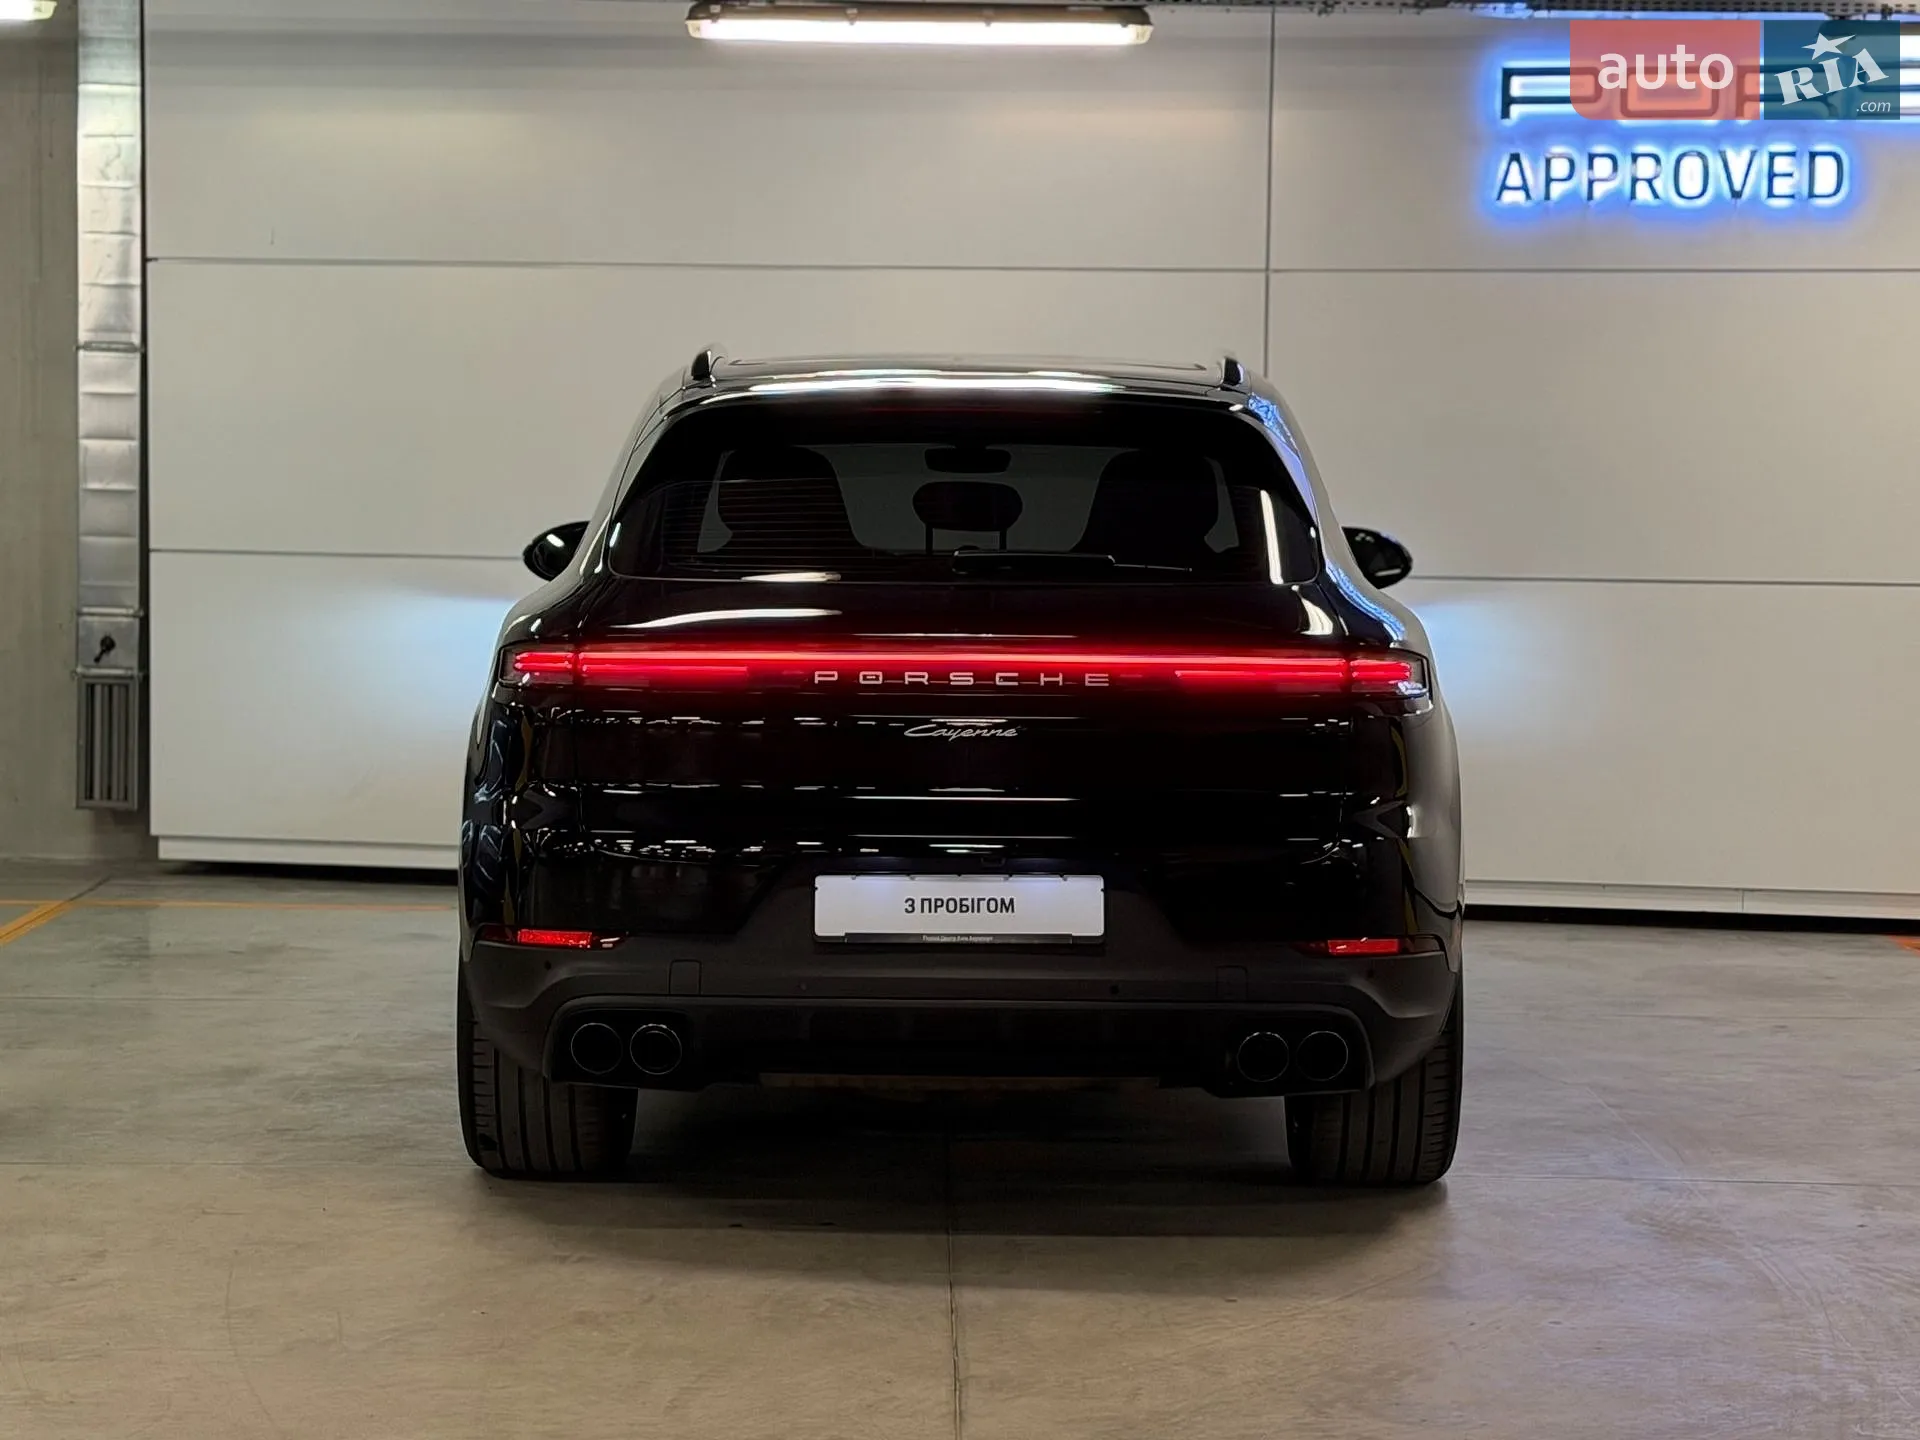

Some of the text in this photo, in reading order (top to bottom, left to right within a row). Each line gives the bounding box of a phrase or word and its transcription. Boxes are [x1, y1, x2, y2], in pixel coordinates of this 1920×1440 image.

[1496, 150, 1846, 202] APPROVED
[814, 671, 1110, 687] PORSCHE
[903, 722, 1019, 741] Cayenne
[920, 897, 1016, 914] ПРОБІГОМ
